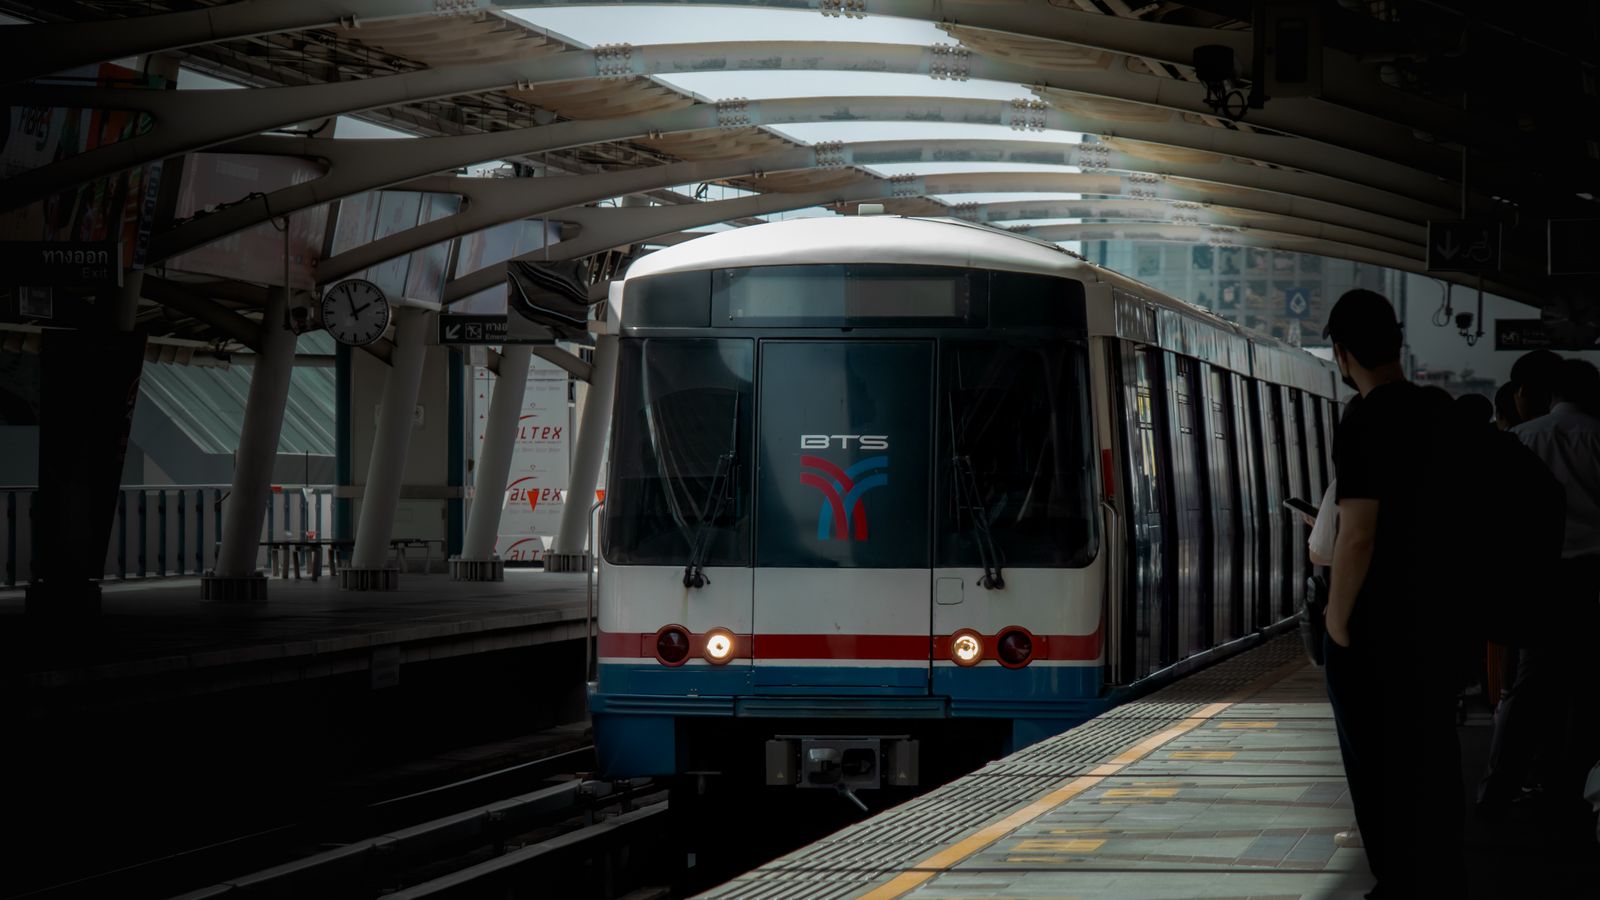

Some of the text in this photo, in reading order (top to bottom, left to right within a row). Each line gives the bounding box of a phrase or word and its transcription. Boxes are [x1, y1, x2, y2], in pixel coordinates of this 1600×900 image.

[42, 249, 108, 264] ทางออก
[82, 266, 108, 279] Exit
[800, 434, 889, 450] BTS
